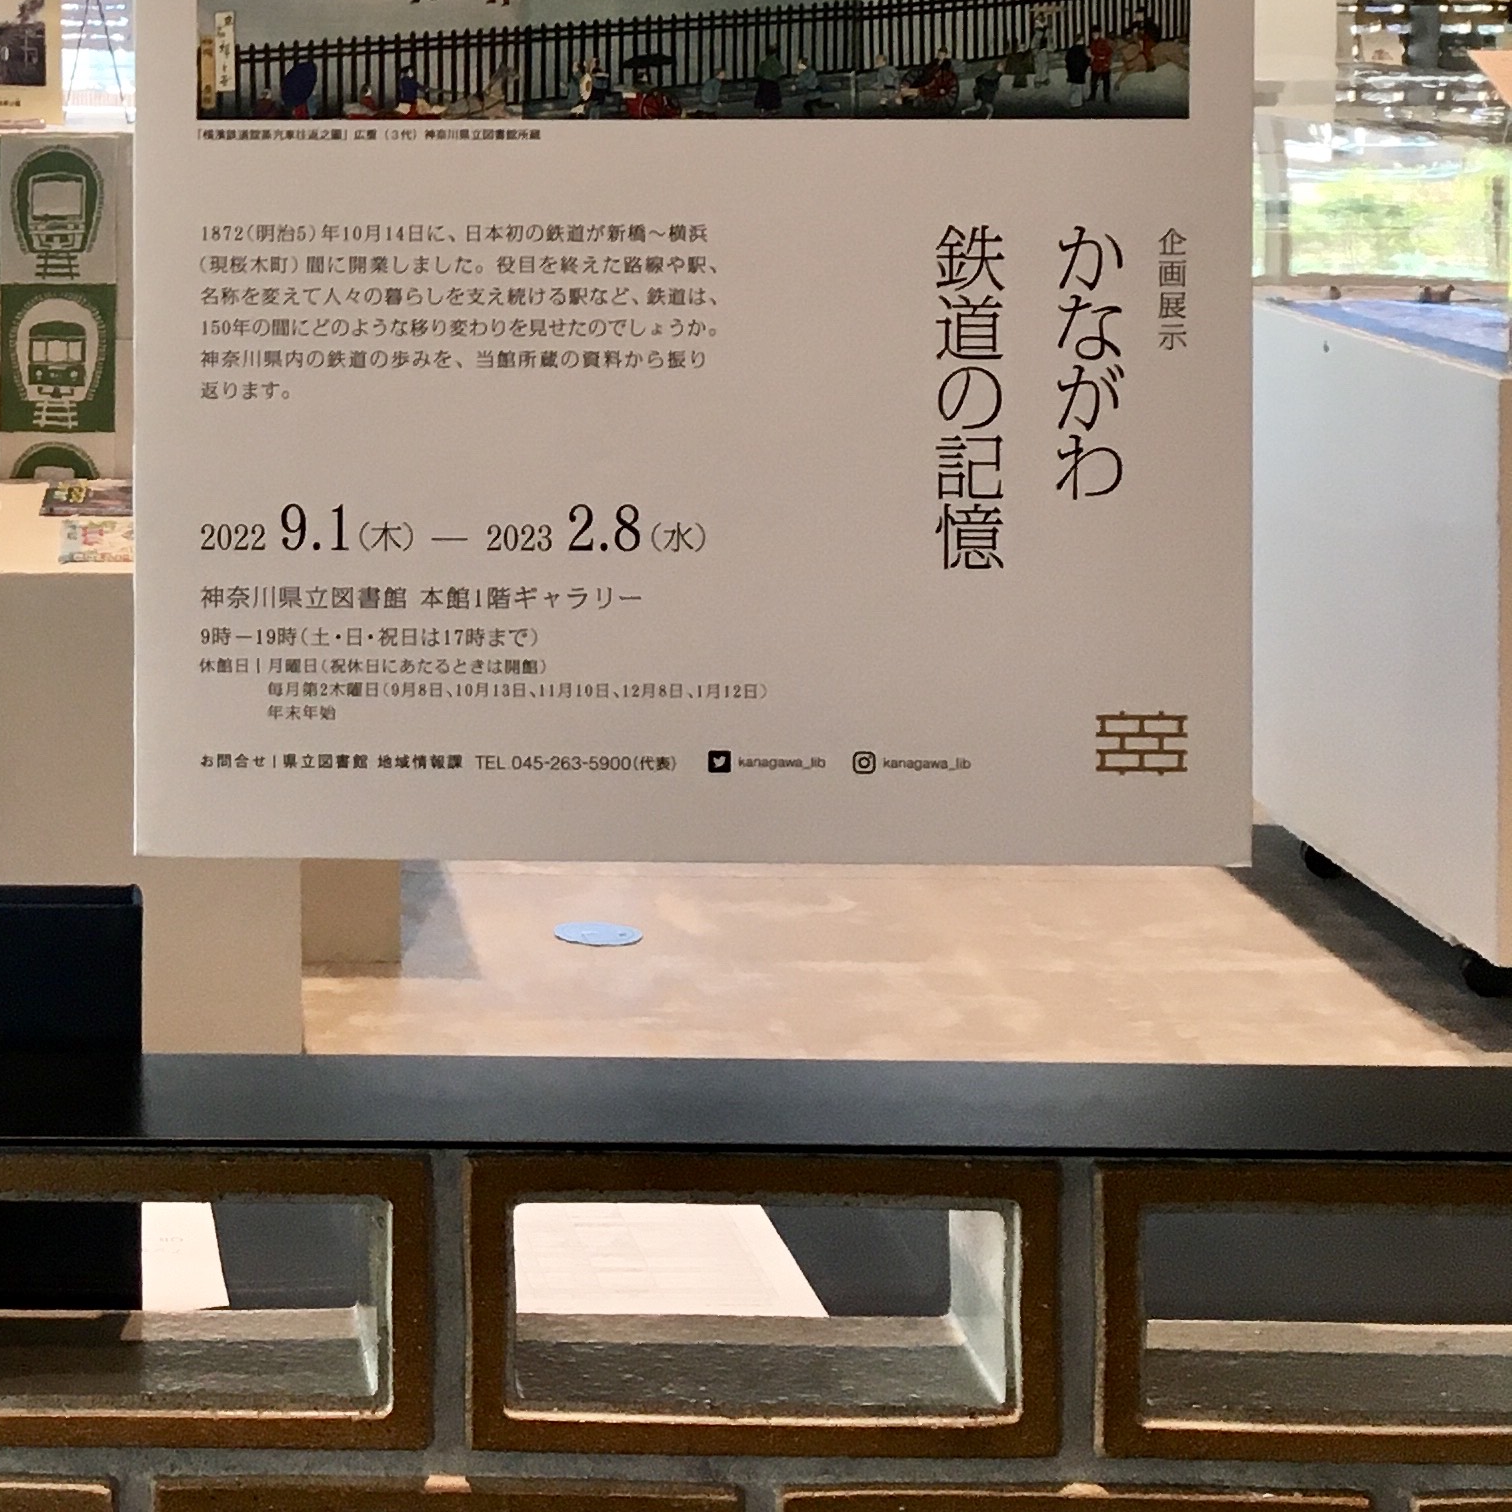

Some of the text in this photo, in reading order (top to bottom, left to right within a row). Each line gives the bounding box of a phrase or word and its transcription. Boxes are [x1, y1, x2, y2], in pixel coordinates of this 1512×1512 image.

[1157, 227, 1188, 352] 企画展示
[1055, 225, 1126, 501] かながわ
[200, 381, 290, 400] 返ります。
[935, 224, 1007, 571] 鉄道の記憶
[200, 523, 267, 552] 2022
[486, 524, 553, 552] 2023
[200, 585, 643, 610] 神奈川県立図書館 本館1階ギャラリー
[267, 704, 337, 721] 年末年始
[377, 753, 464, 770] 地域情報課
[738, 756, 827, 772] kanagawa_lib
[882, 757, 973, 773] kanagawa_lib
